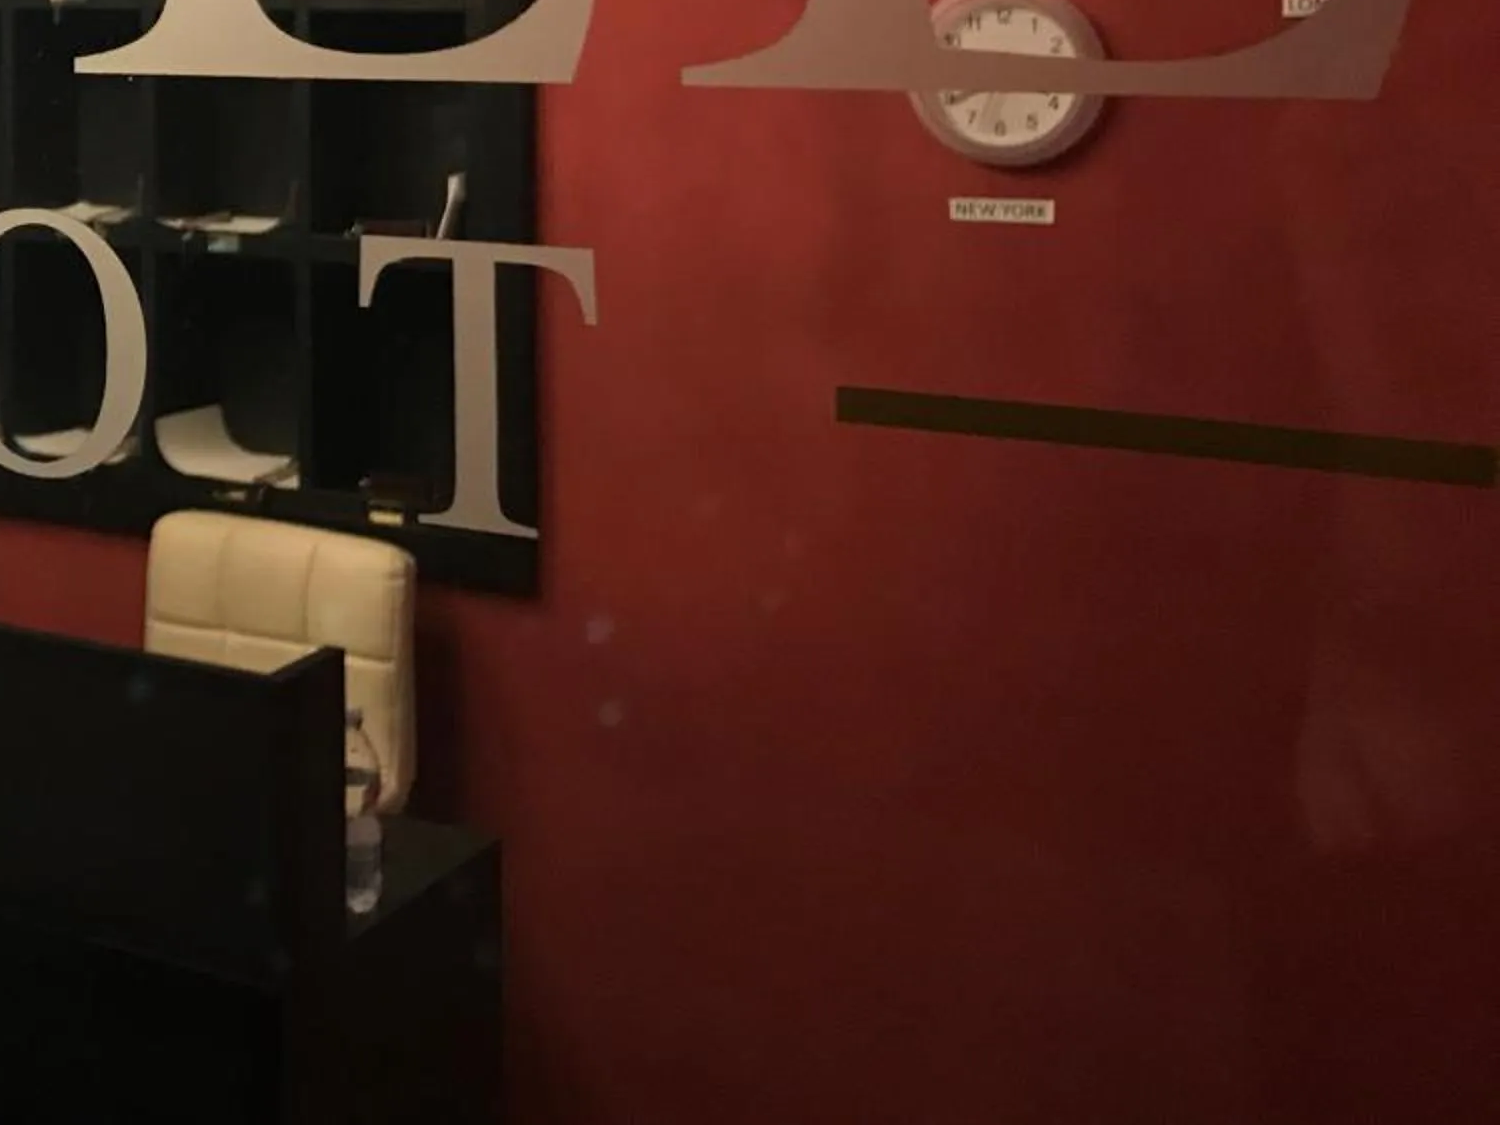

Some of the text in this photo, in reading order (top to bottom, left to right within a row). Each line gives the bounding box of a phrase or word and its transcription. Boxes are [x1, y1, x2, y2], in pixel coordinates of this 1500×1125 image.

[966, 12, 981, 31] 11
[997, 8, 1013, 26] 12
[1051, 35, 1064, 54] 2
[967, 109, 977, 125] 7
[994, 119, 1007, 137] 6
[955, 202, 1046, 218] NEW YORK
